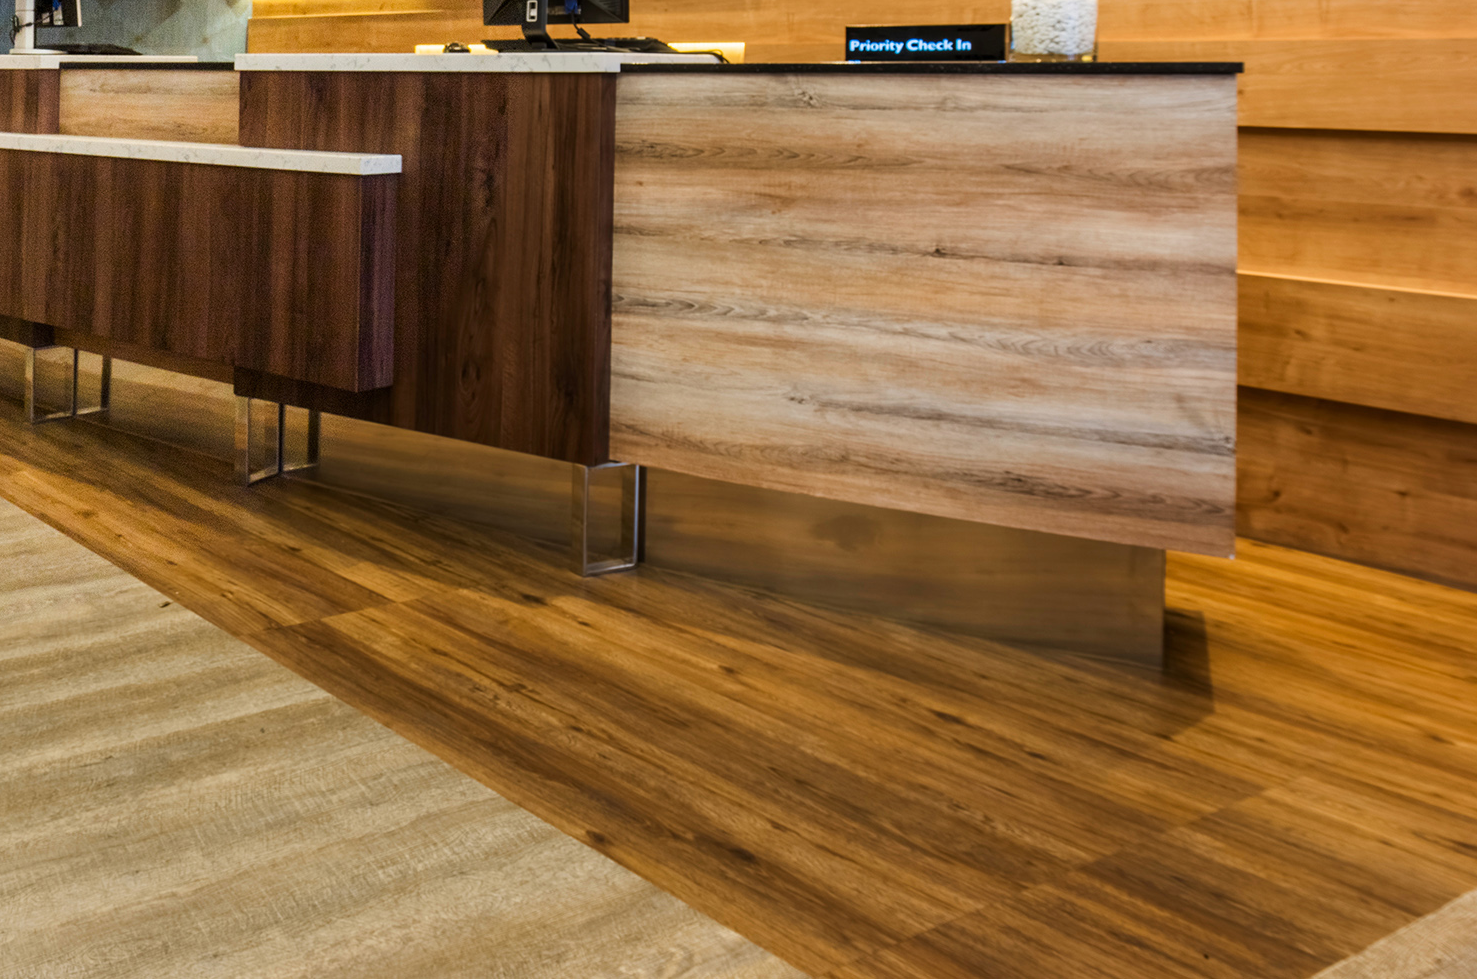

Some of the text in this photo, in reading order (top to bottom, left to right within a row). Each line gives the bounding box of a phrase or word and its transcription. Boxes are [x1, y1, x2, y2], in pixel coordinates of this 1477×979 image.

[849, 38, 972, 54] Priority Check In
